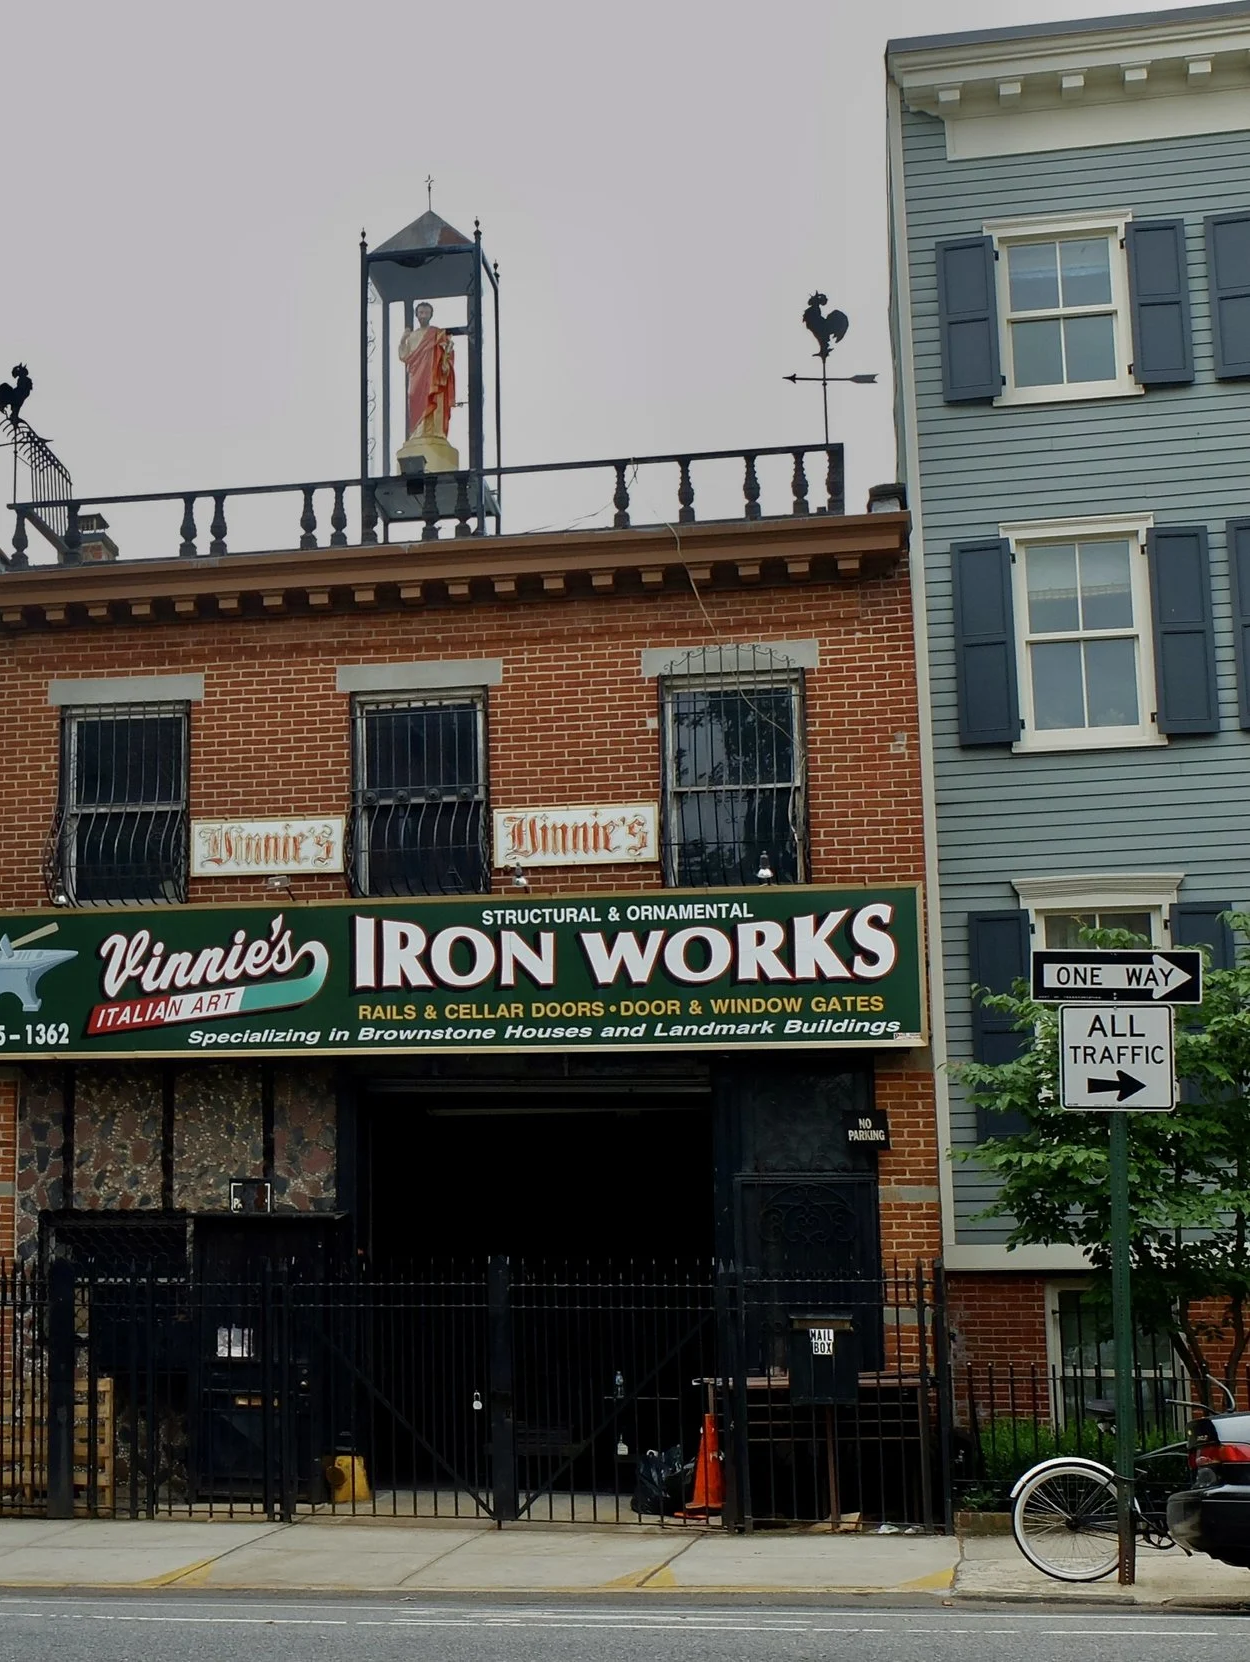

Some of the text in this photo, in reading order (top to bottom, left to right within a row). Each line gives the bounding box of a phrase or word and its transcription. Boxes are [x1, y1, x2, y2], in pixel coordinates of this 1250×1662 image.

[200, 823, 335, 867] Vinnie's
[503, 810, 648, 858] Vinnie's
[482, 902, 754, 925] STRUCTURAL & ORNAMENTAL
[100, 914, 295, 997] Vinnie's
[354, 903, 897, 990] IRON WORKS
[1057, 967, 1174, 987] ONE WAY
[97, 993, 235, 1028] ITALIAN ART
[358, 1005, 417, 1020] RAILS
[424, 1004, 437, 1020] &
[444, 1003, 523, 1019] CELLAR
[689, 1000, 702, 1016] &
[710, 998, 803, 1015] WINDOW
[811, 996, 884, 1014] GATES
[188, 1018, 901, 1046] Specializing in Brownstone Houses and Landmark Buildings
[1087, 1014, 1146, 1038] ALL
[1069, 1045, 1164, 1065] TRAFFIC
[848, 1129, 885, 1140] PARKING
[858, 1117, 872, 1129] NO
[810, 1329, 832, 1341] MAIL
[814, 1341, 832, 1353] BOX
